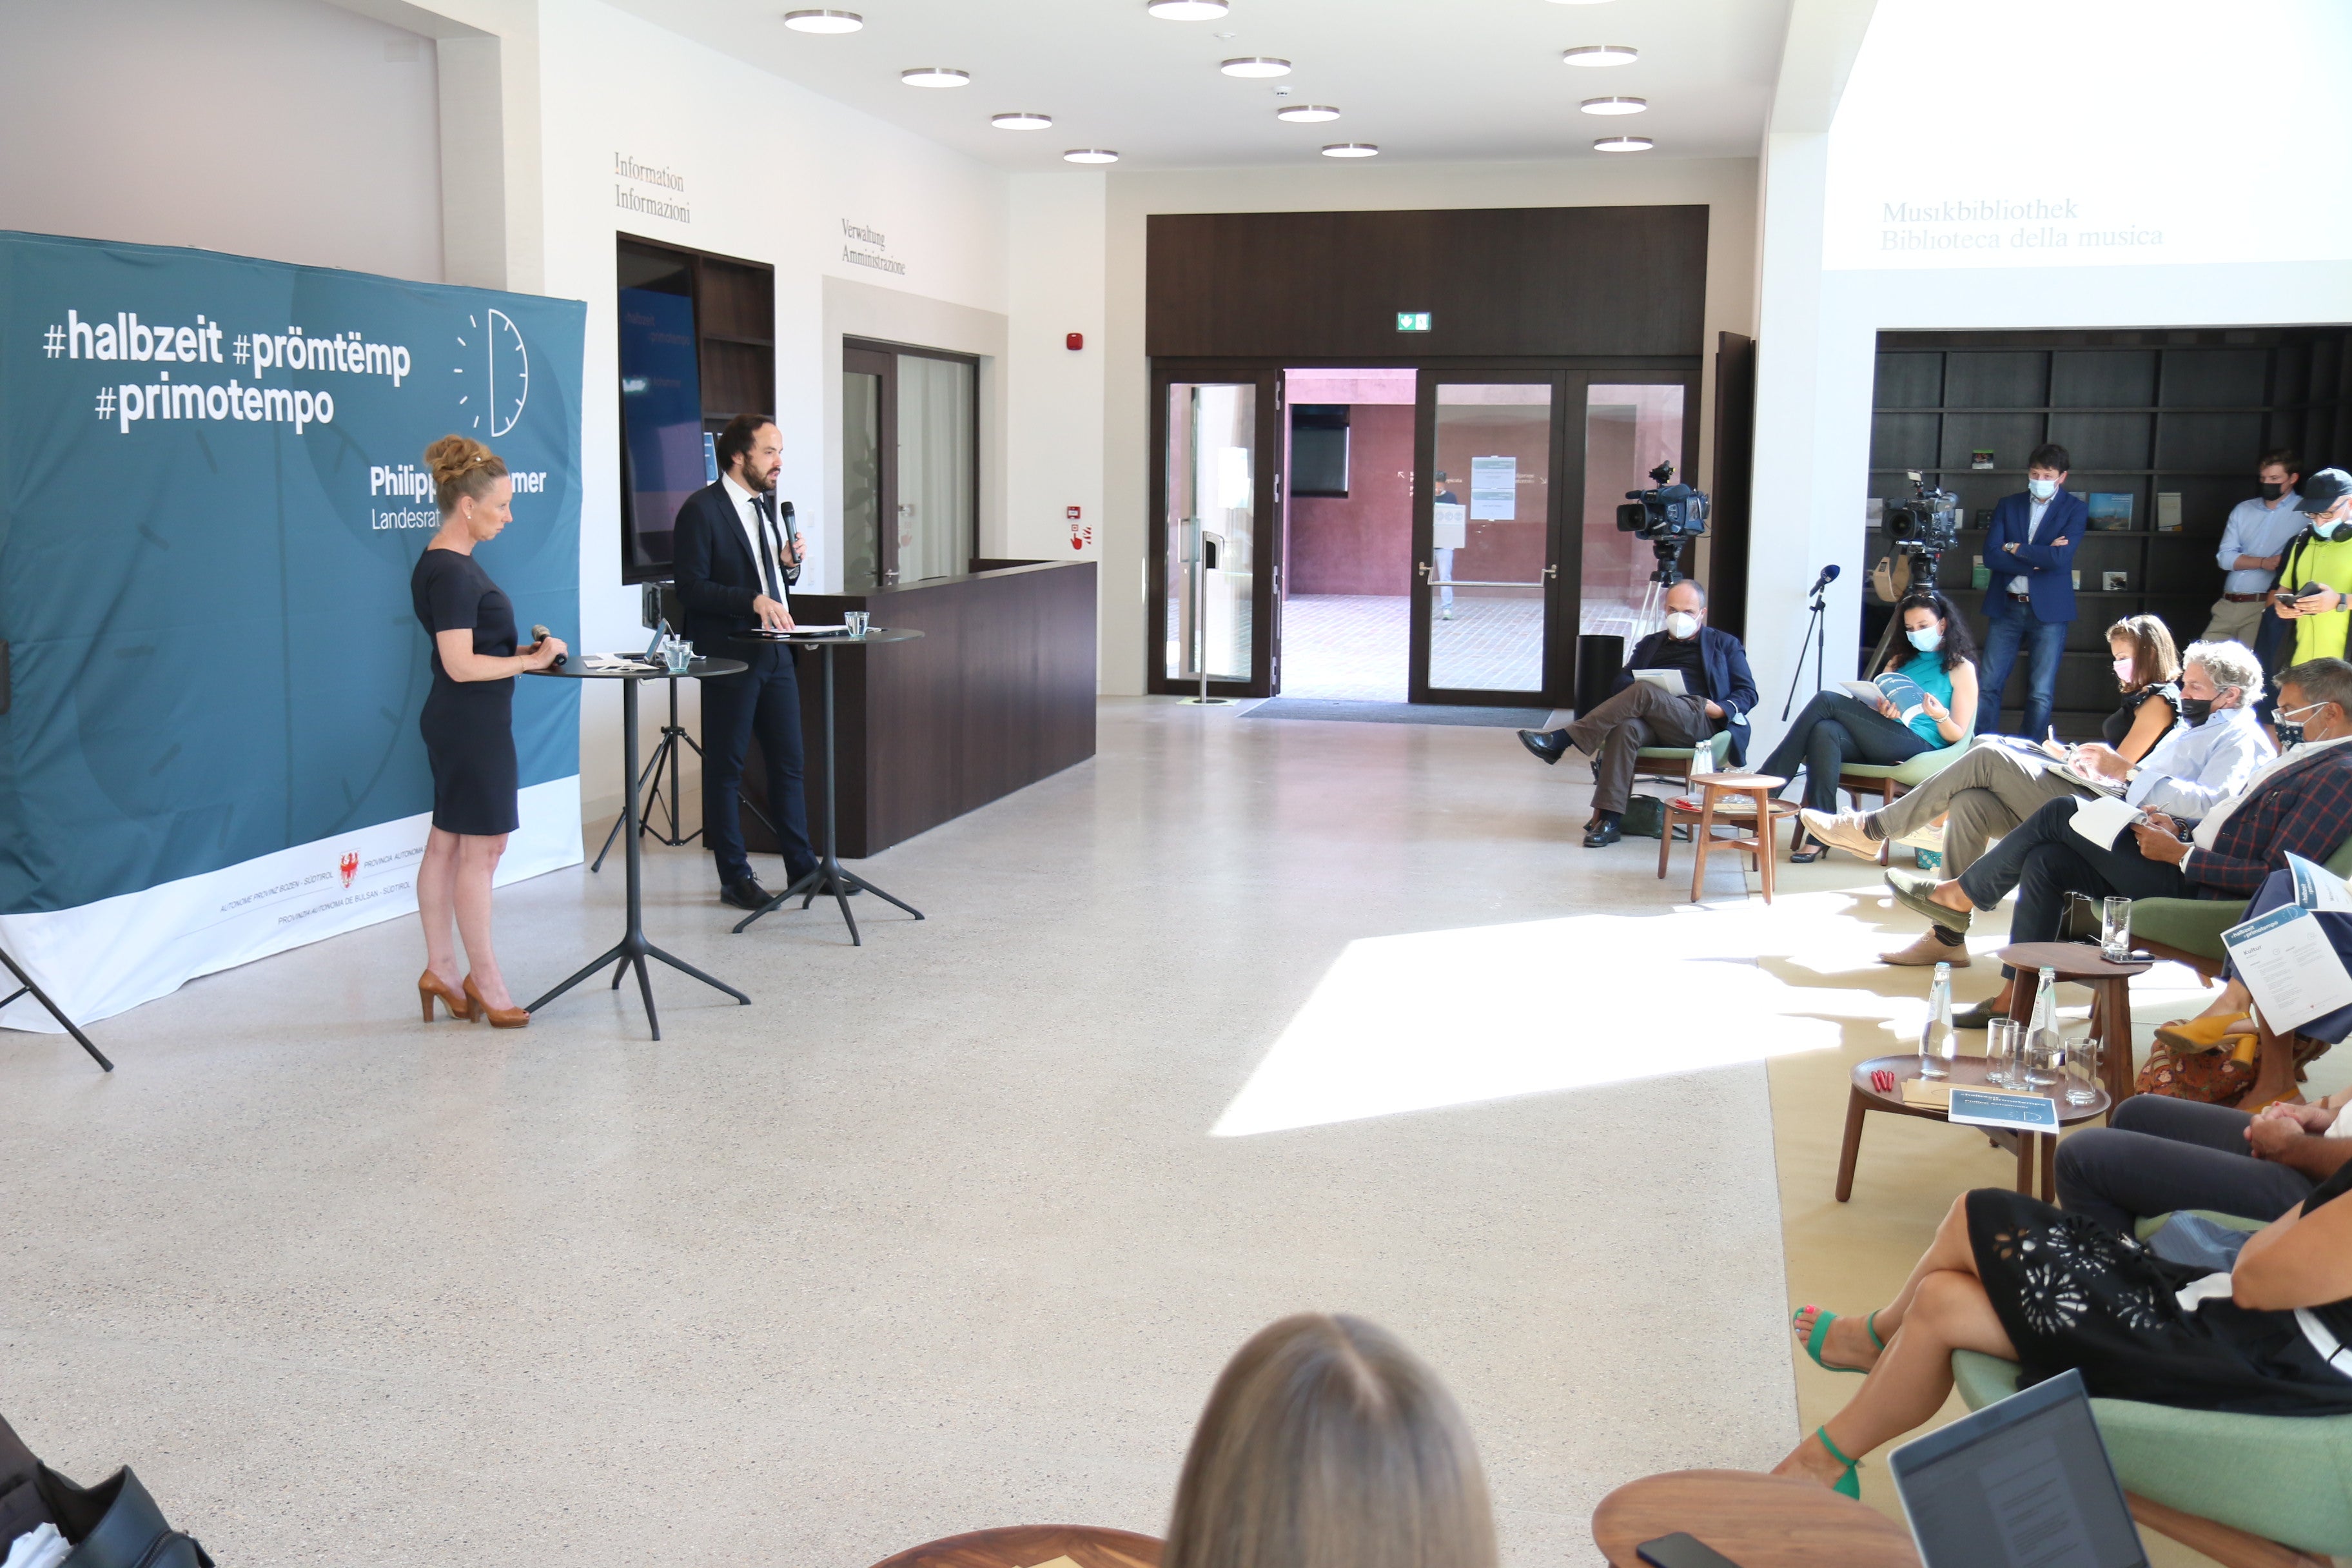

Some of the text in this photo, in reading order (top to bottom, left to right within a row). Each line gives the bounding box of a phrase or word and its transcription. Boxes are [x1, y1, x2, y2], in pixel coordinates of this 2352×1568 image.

[615, 152, 684, 192] Information
[615, 184, 690, 224] Informazioni
[1882, 198, 2079, 222] Musikbibliothek
[841, 218, 885, 251] Verwaltung
[1881, 224, 2164, 251] Biblioteca della musica
[842, 244, 906, 275] Amministrazione
[43, 309, 411, 387] #halbzeit #prömtëmp
[95, 371, 335, 435] #primotempo
[364, 854, 393, 868] PROVINCIA
[394, 846, 424, 860] AUTONOMA
[253, 887, 279, 901] PROVINZ
[279, 880, 300, 893] BOZEN
[345, 896, 354, 905] DE
[355, 890, 379, 903] BULSAN
[2243, 945, 2262, 955] Kultur
